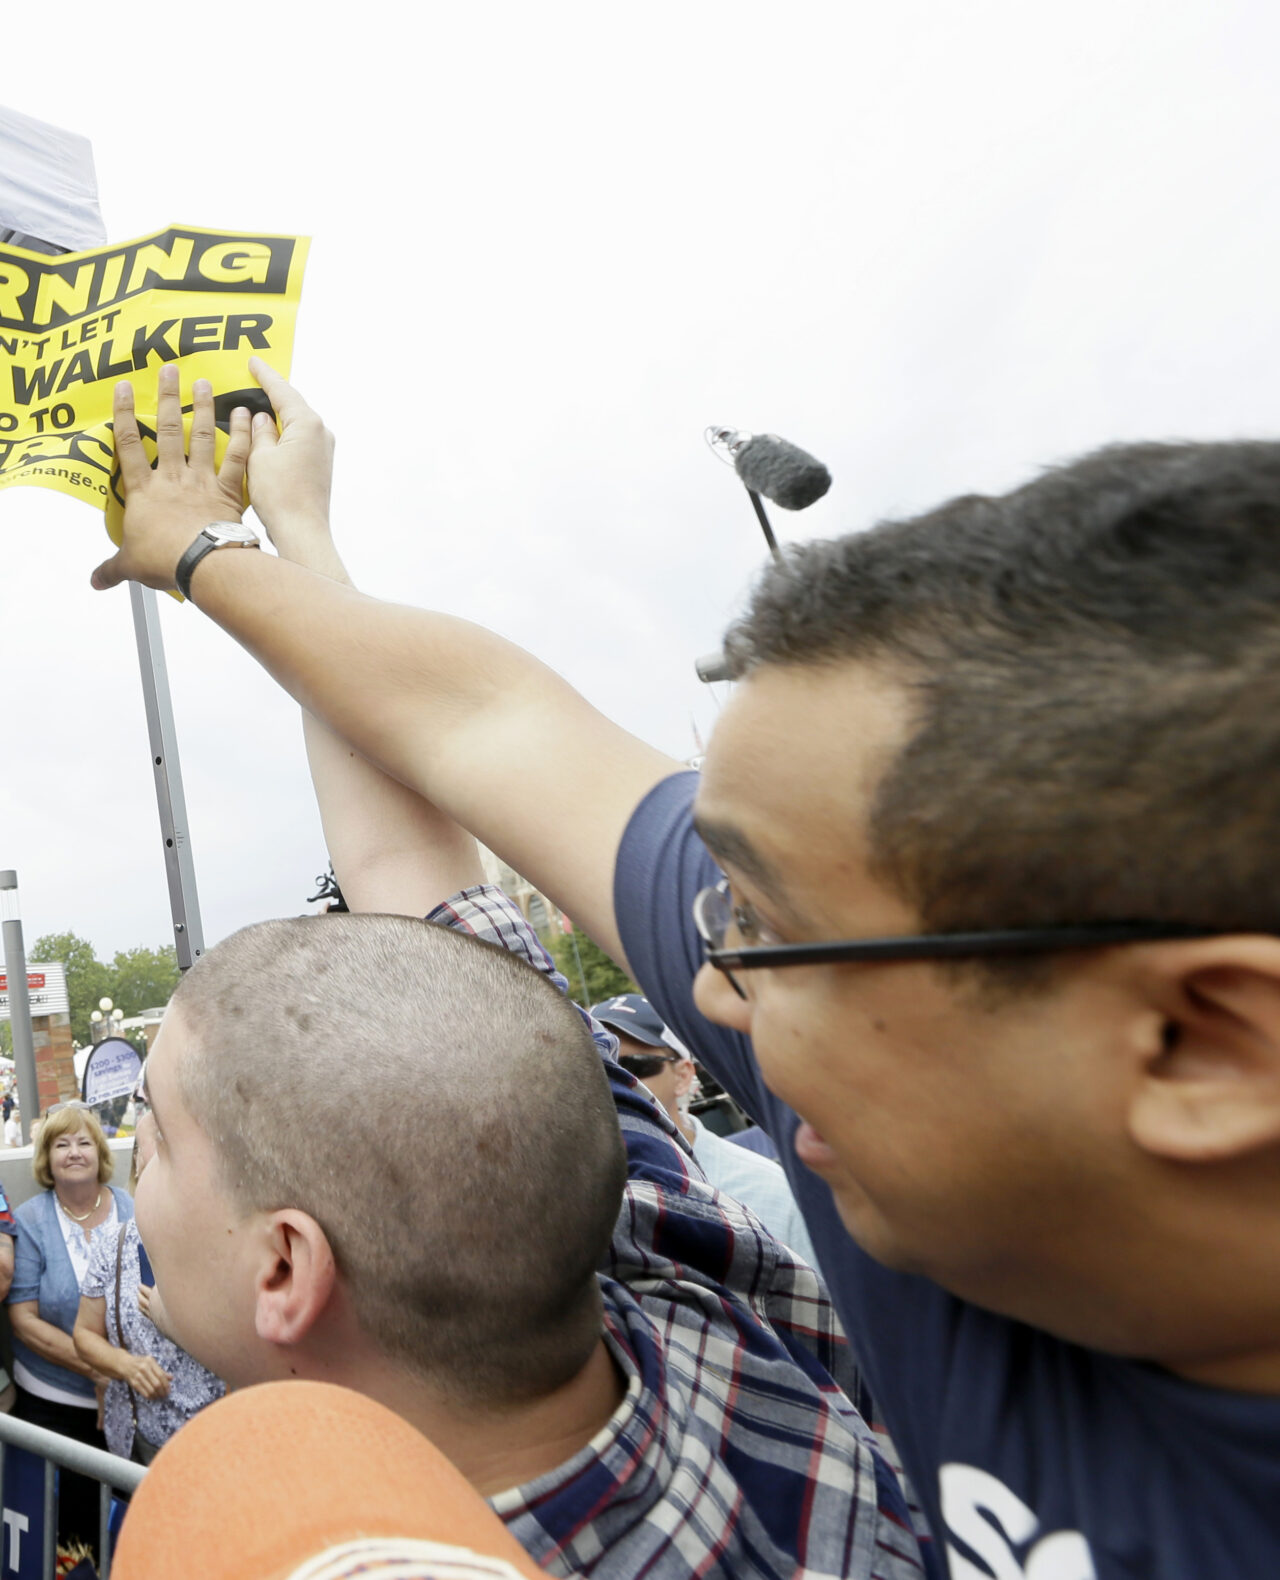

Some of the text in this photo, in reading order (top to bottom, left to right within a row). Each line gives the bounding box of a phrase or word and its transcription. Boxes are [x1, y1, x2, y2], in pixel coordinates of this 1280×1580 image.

[61, 308, 122, 351] LET
[11, 313, 274, 405] WALKER
[29, 403, 76, 433] TO
